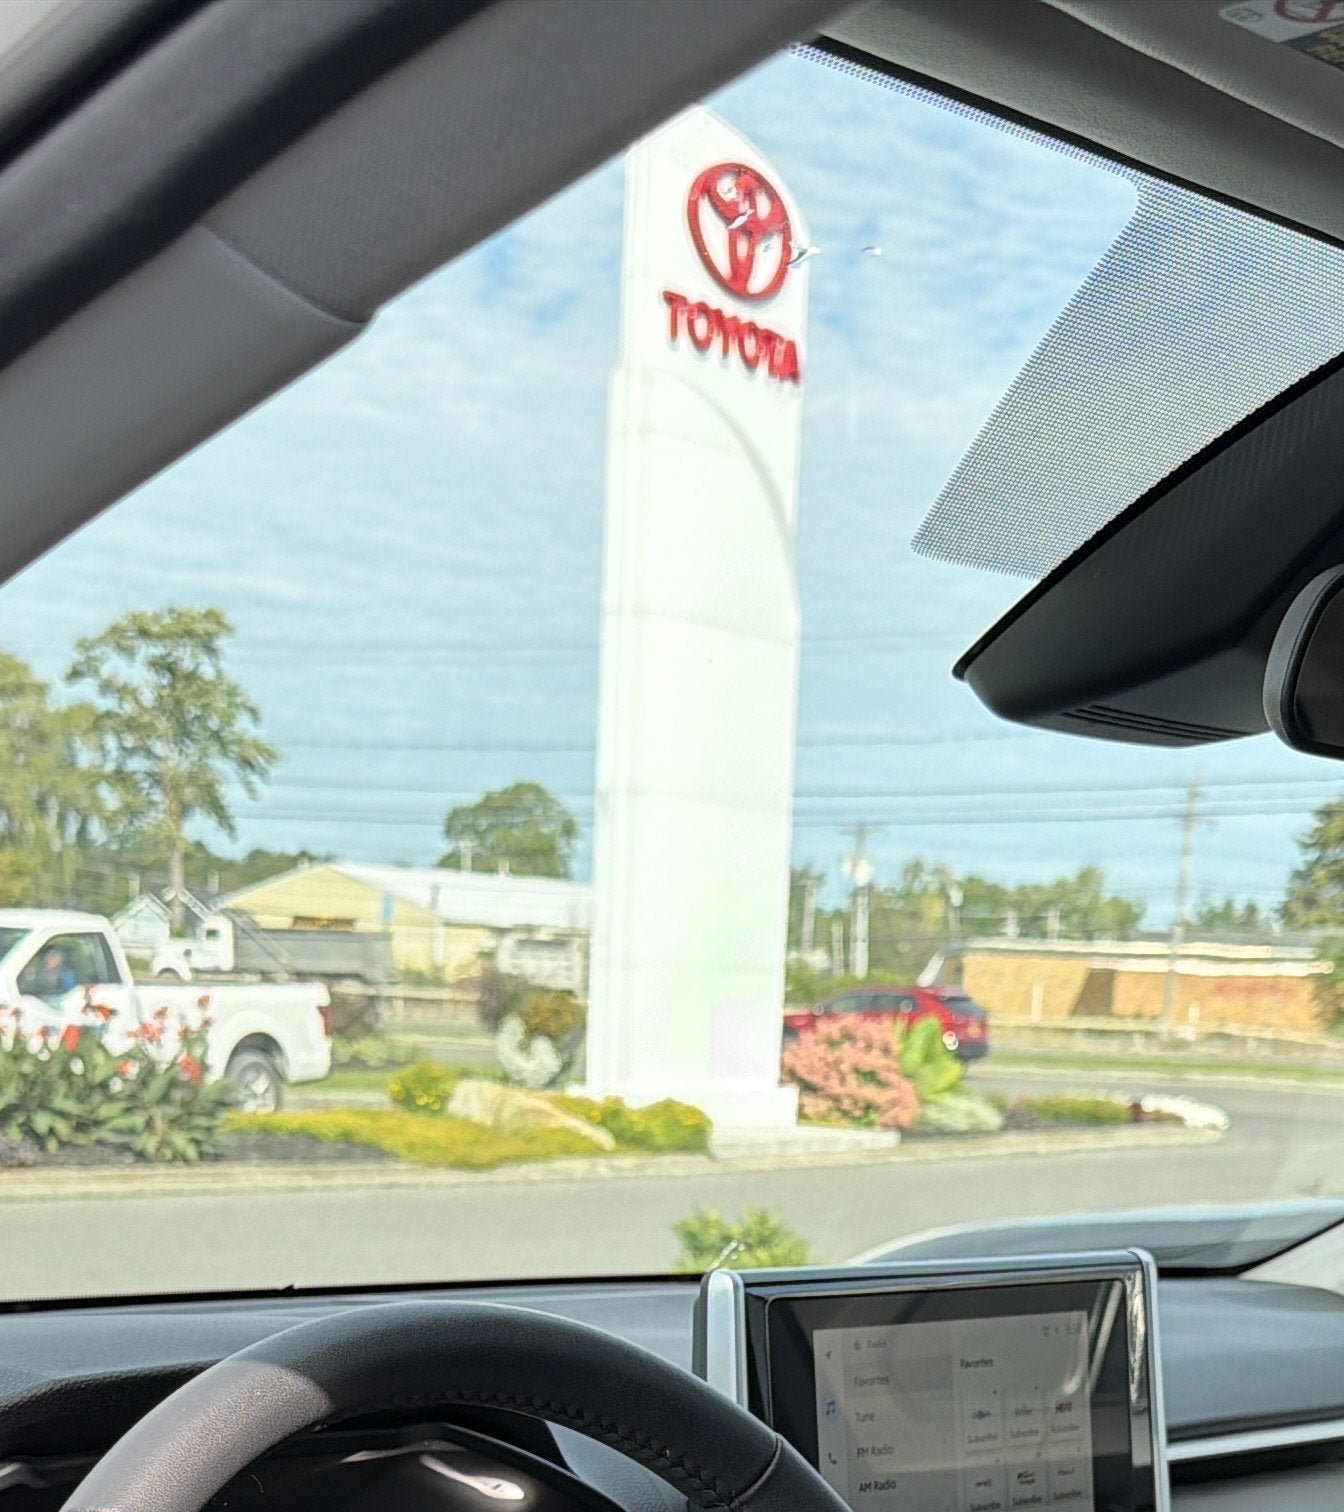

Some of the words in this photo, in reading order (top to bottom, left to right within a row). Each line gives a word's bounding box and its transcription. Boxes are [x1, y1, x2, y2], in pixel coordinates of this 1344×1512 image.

[662, 291, 801, 386] TOYOTA
[960, 1358, 994, 1369] Favorites
[854, 1376, 890, 1387] Favorites
[855, 1412, 876, 1422] Tune
[856, 1447, 869, 1458] FM
[871, 1444, 895, 1456] Radio
[859, 1482, 872, 1493] AM
[874, 1479, 897, 1491] Radio
[970, 1500, 1001, 1512] Subscribe
